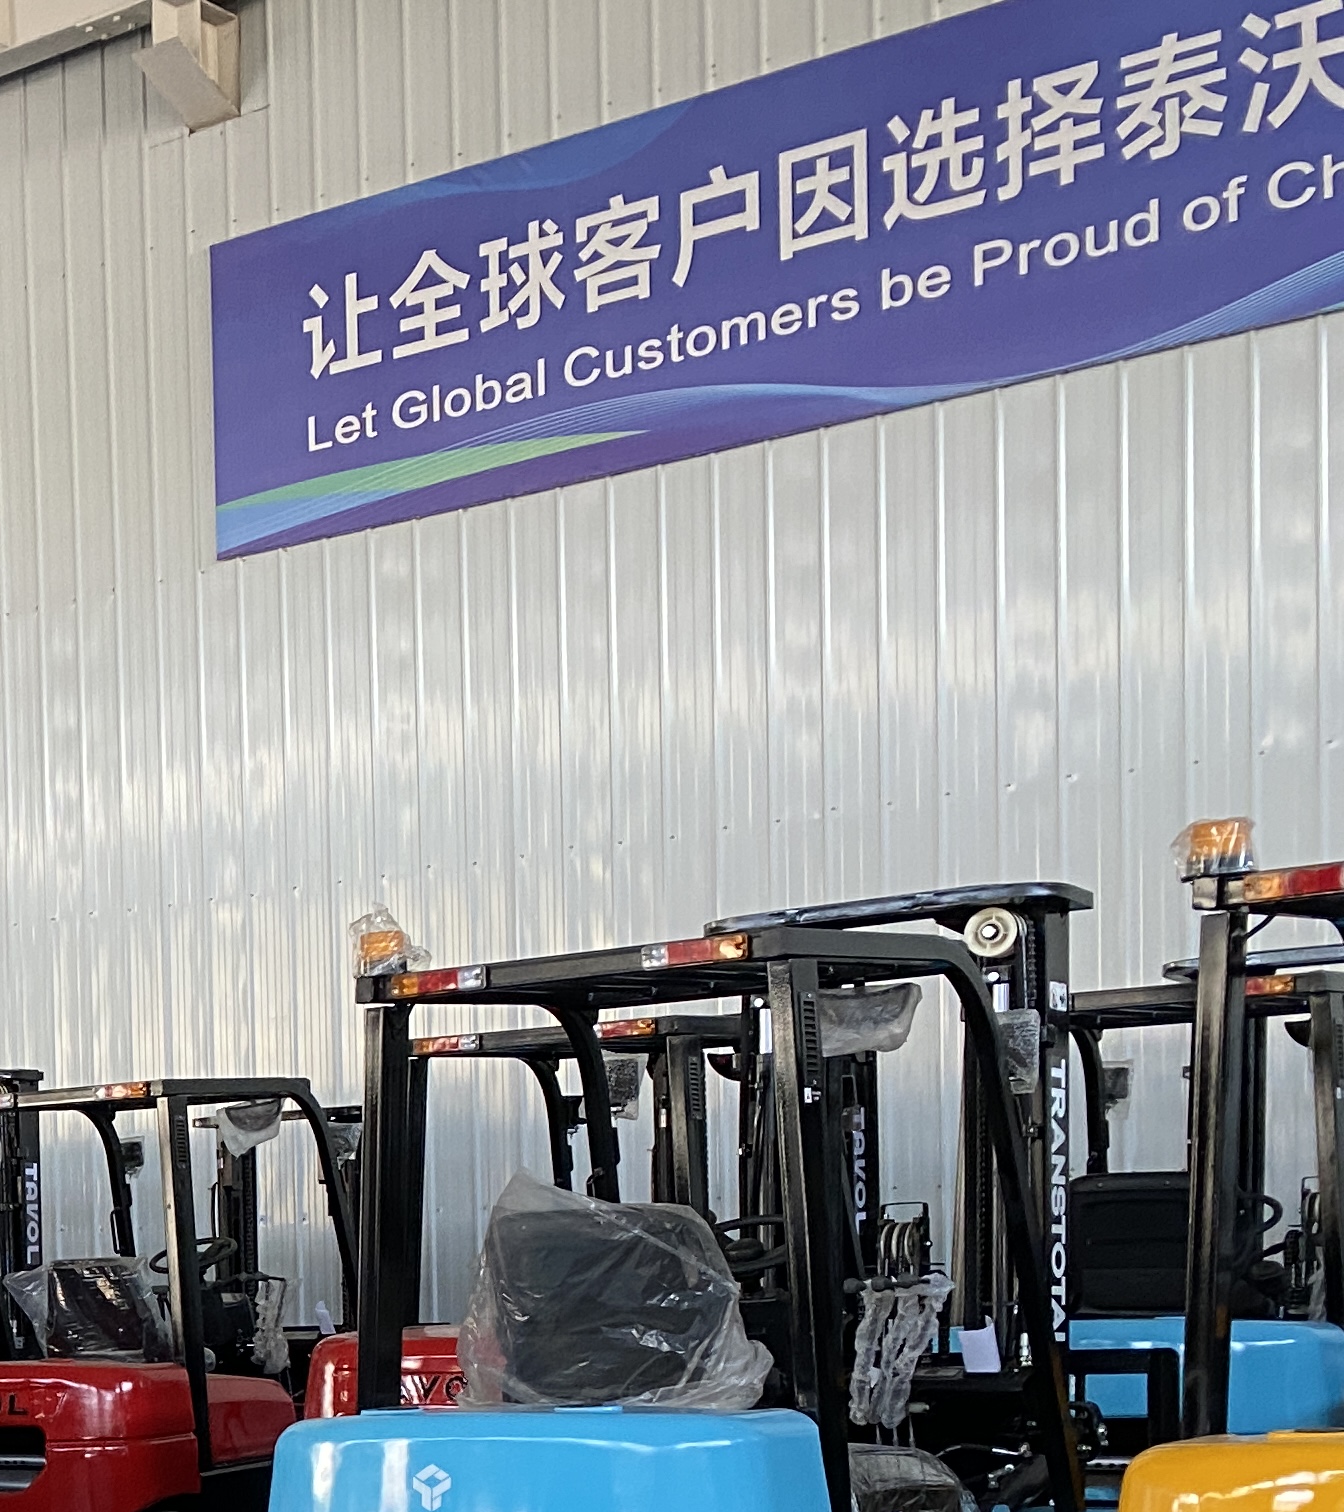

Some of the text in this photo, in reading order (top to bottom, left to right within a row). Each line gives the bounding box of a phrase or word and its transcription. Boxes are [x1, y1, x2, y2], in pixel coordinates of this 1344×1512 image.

[302, 0, 1344, 380] 让全球客户因选择泰沃
[307, 401, 378, 452] Let
[391, 358, 546, 430] Global
[563, 285, 861, 388] Customers
[880, 264, 952, 310] be
[973, 197, 1160, 287] Proud
[1182, 174, 1248, 232] of
[24, 1162, 40, 1265] TAVOL
[852, 1106, 867, 1235] TAVOL
